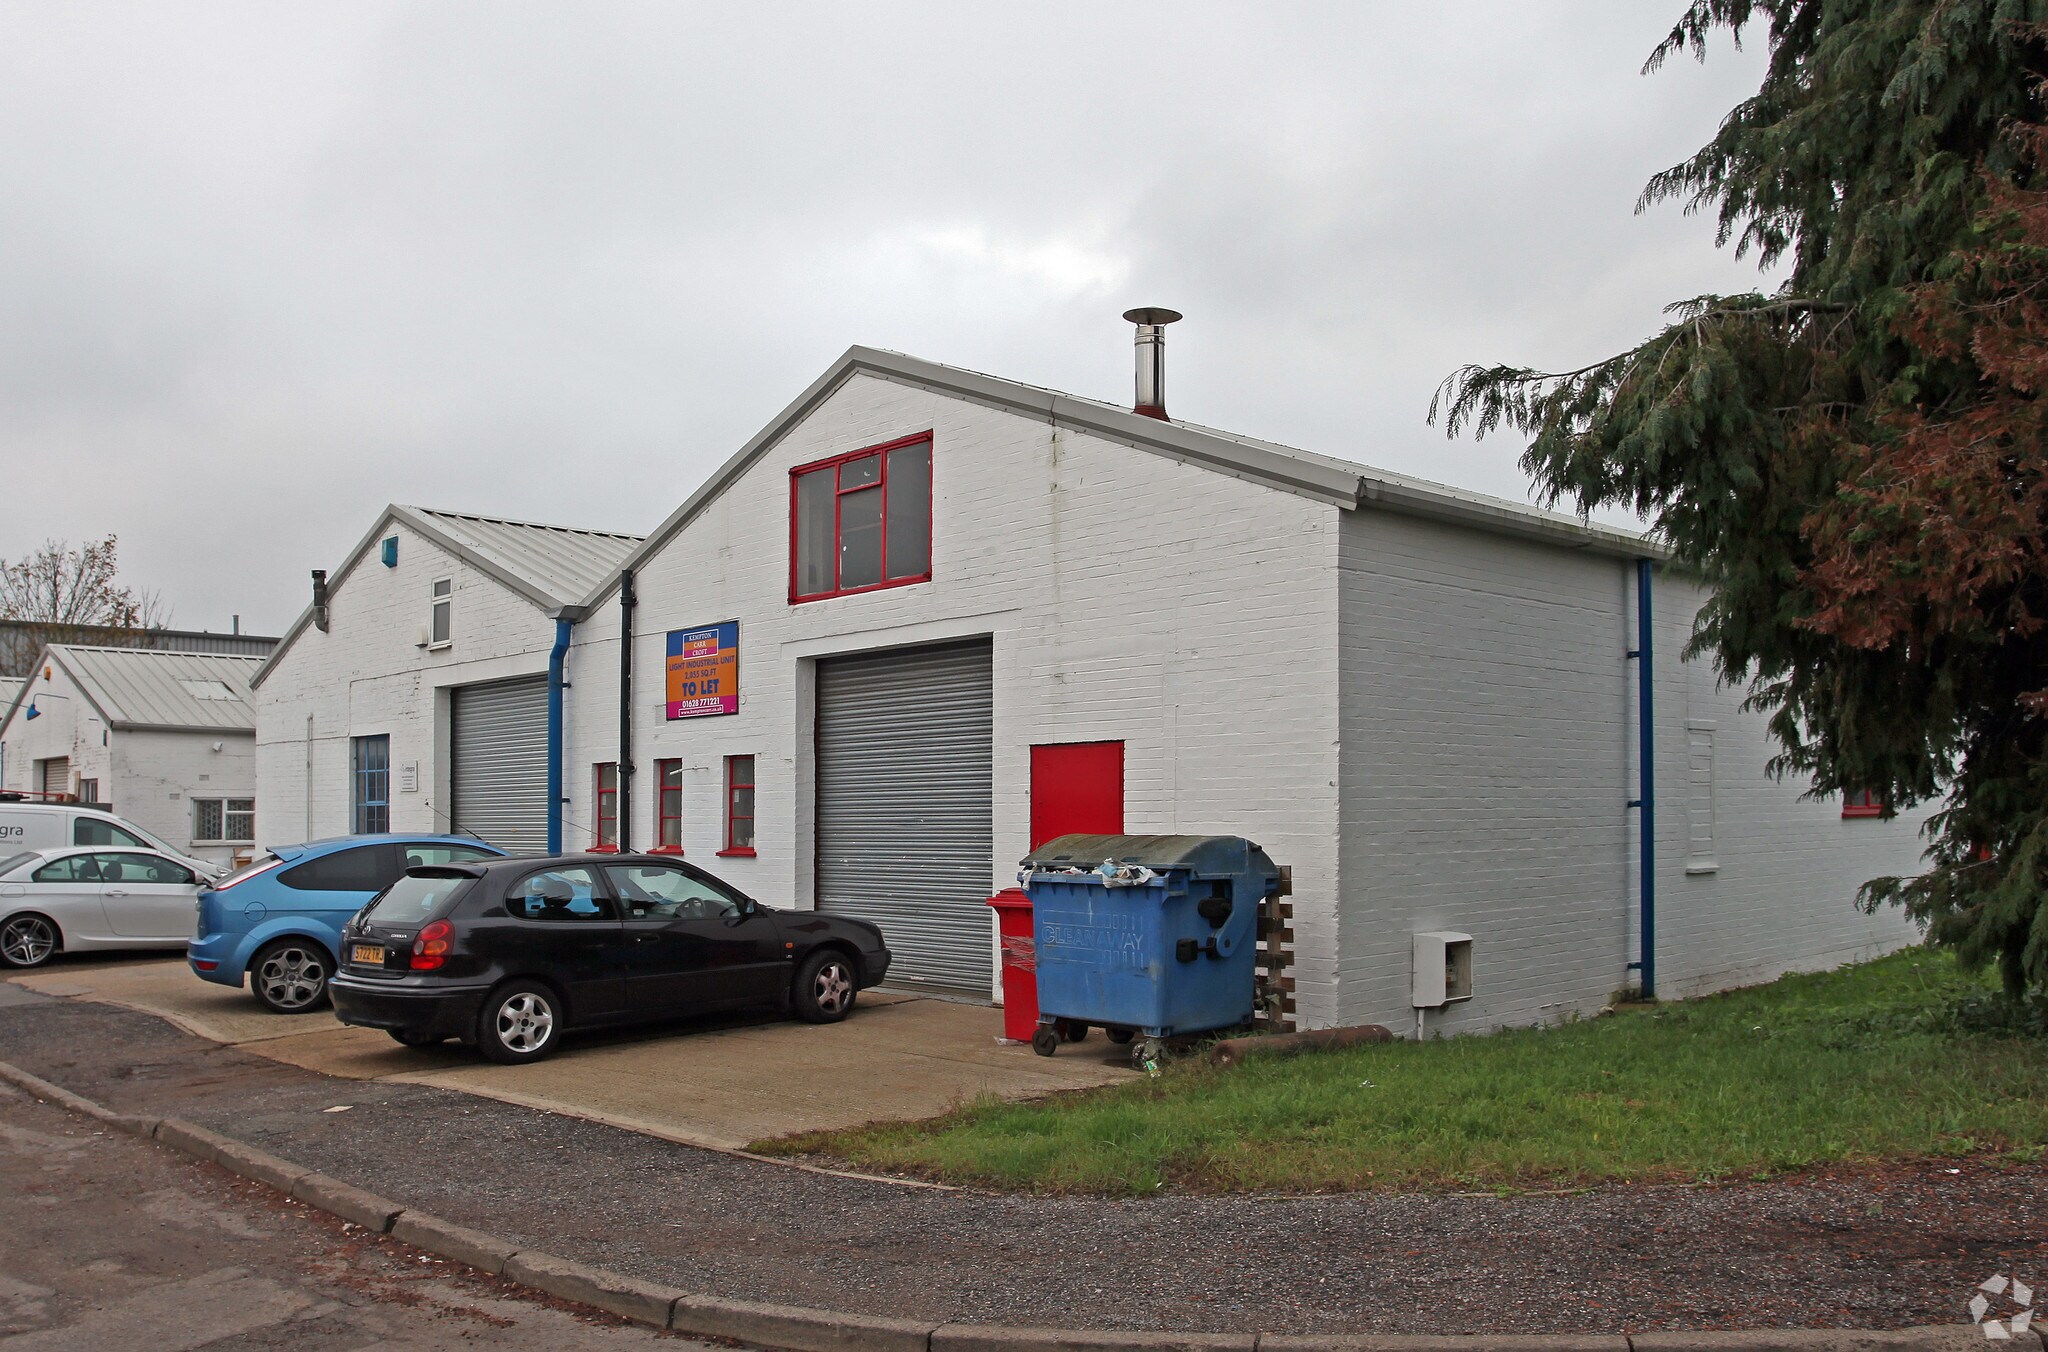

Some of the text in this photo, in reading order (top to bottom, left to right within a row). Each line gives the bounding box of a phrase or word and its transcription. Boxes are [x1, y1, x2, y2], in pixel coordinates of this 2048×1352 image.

[688, 632, 712, 642] KEMPTON
[693, 640, 707, 648] CARR
[692, 648, 708, 656] CROFT
[669, 655, 735, 671] LIGHT INDUSTRIAL UNIT
[682, 678, 720, 697] TO LET
[681, 696, 720, 708] 01628 771221
[355, 946, 371, 960] S722
